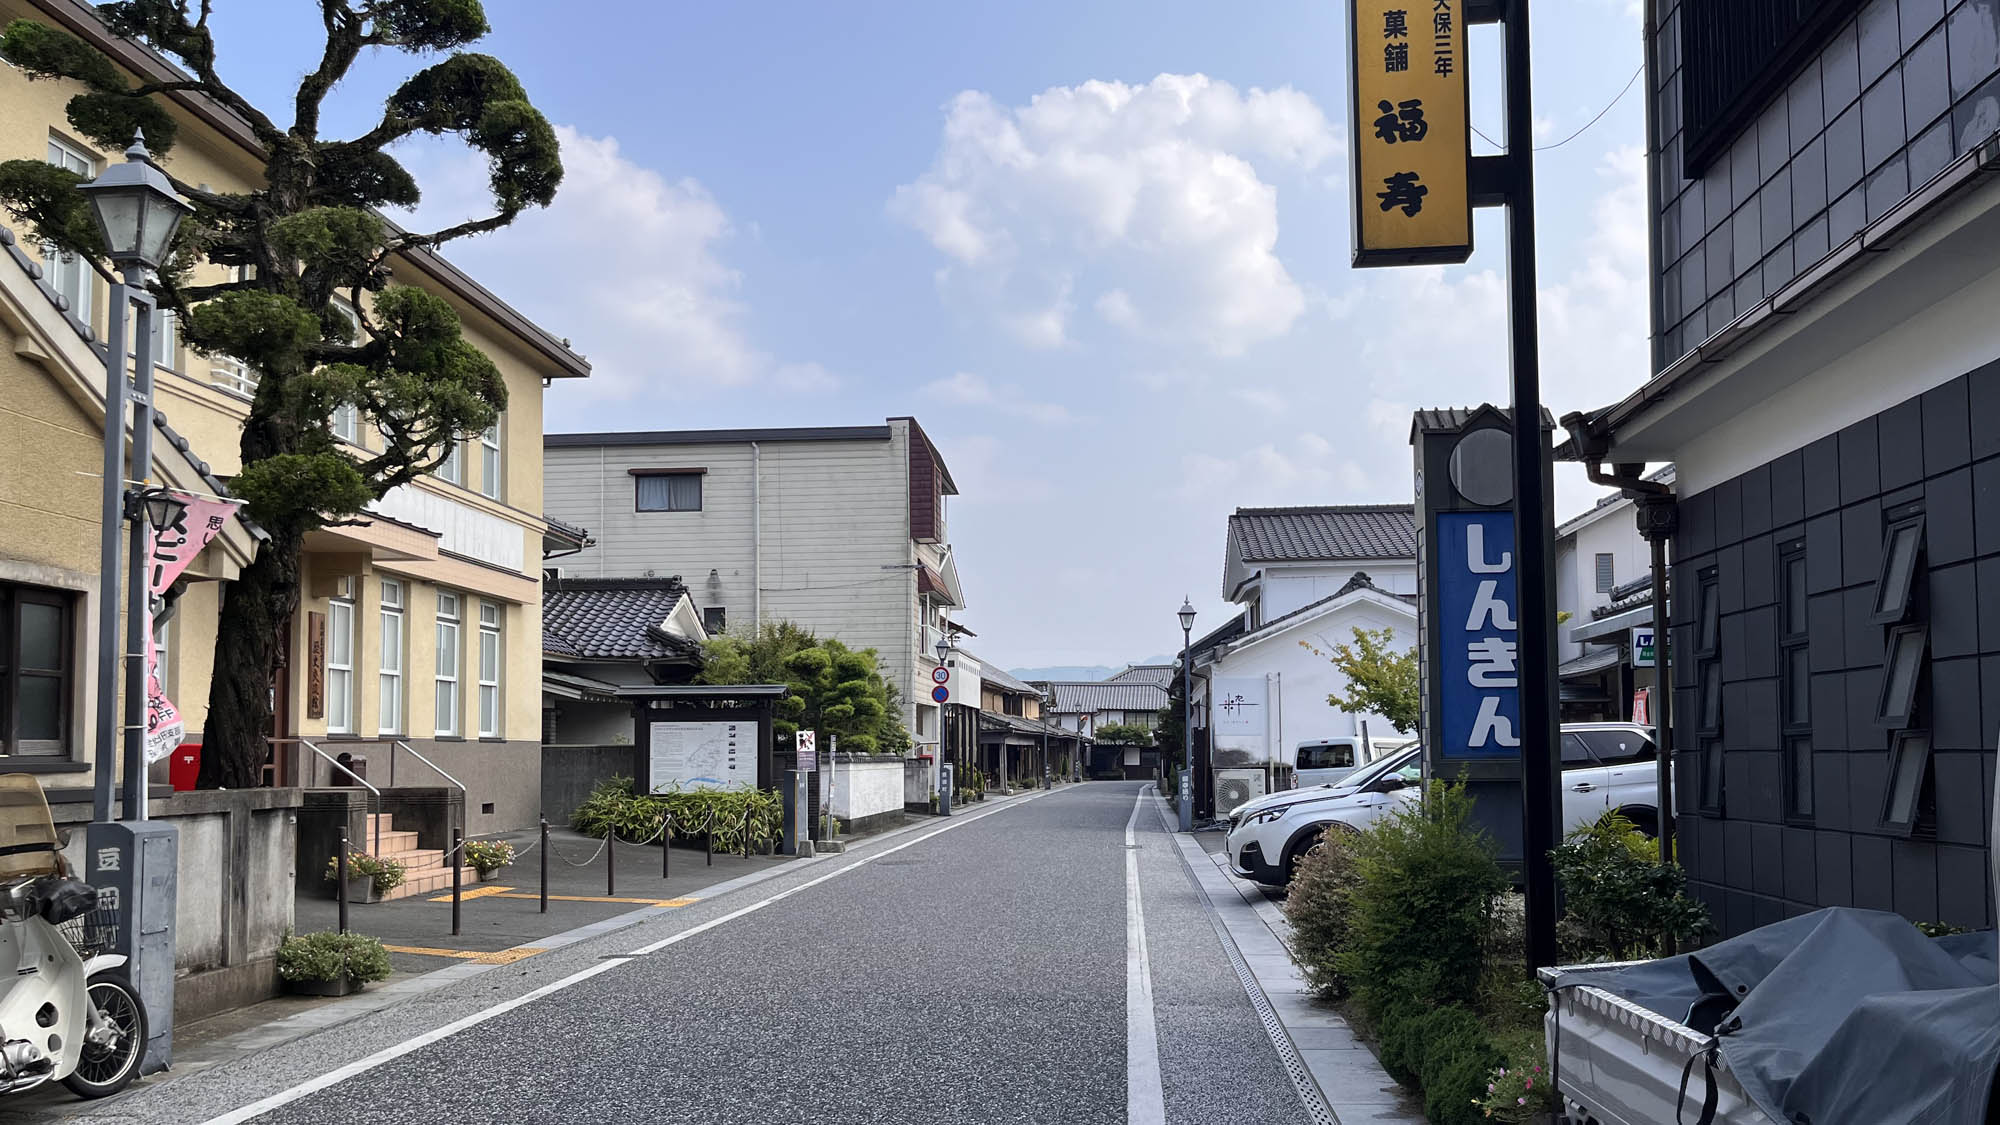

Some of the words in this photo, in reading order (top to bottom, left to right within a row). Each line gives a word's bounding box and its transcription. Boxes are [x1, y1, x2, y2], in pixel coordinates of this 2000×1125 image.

[1373, 99, 1429, 218] 福寿
[935, 671, 946, 680] 30
[1466, 524, 1521, 747] しんきん
